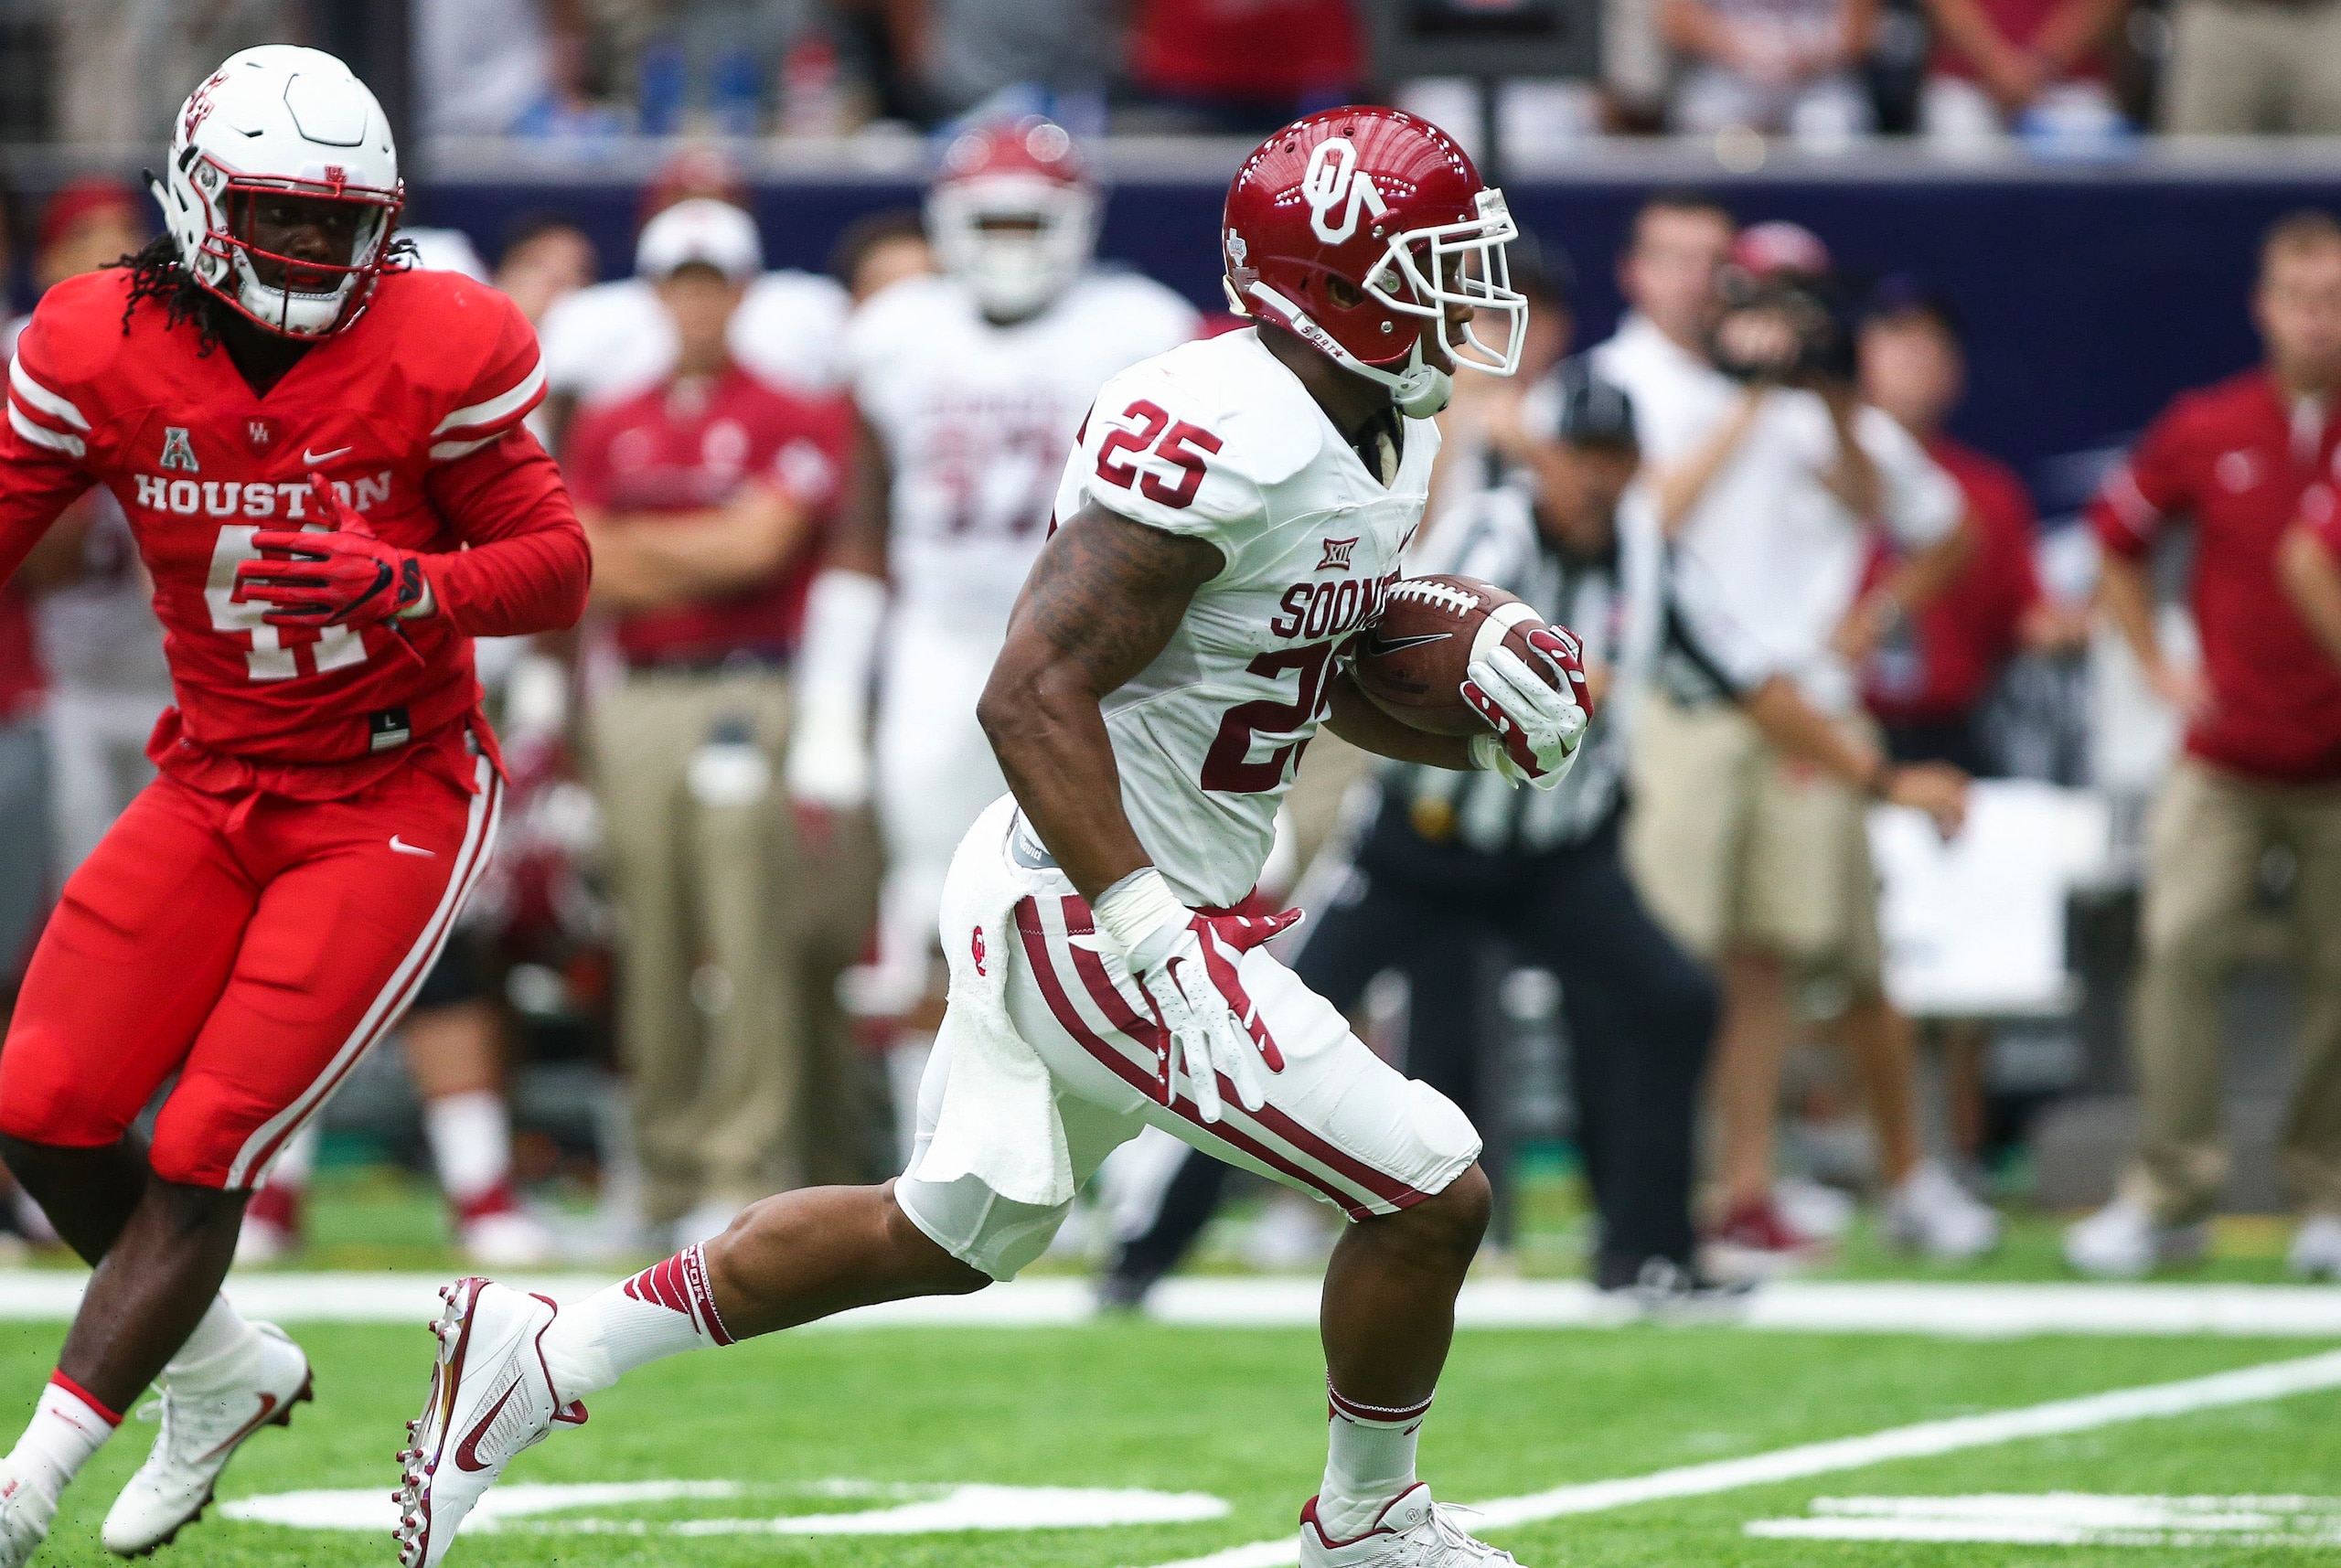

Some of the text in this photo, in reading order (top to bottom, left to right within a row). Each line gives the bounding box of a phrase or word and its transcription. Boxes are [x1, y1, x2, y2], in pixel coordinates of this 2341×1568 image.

[1302, 136, 1388, 245] OU
[159, 426, 199, 473] A
[1096, 399, 1224, 509] 25
[1270, 572, 1399, 639] SOON
[384, 713, 397, 729] L
